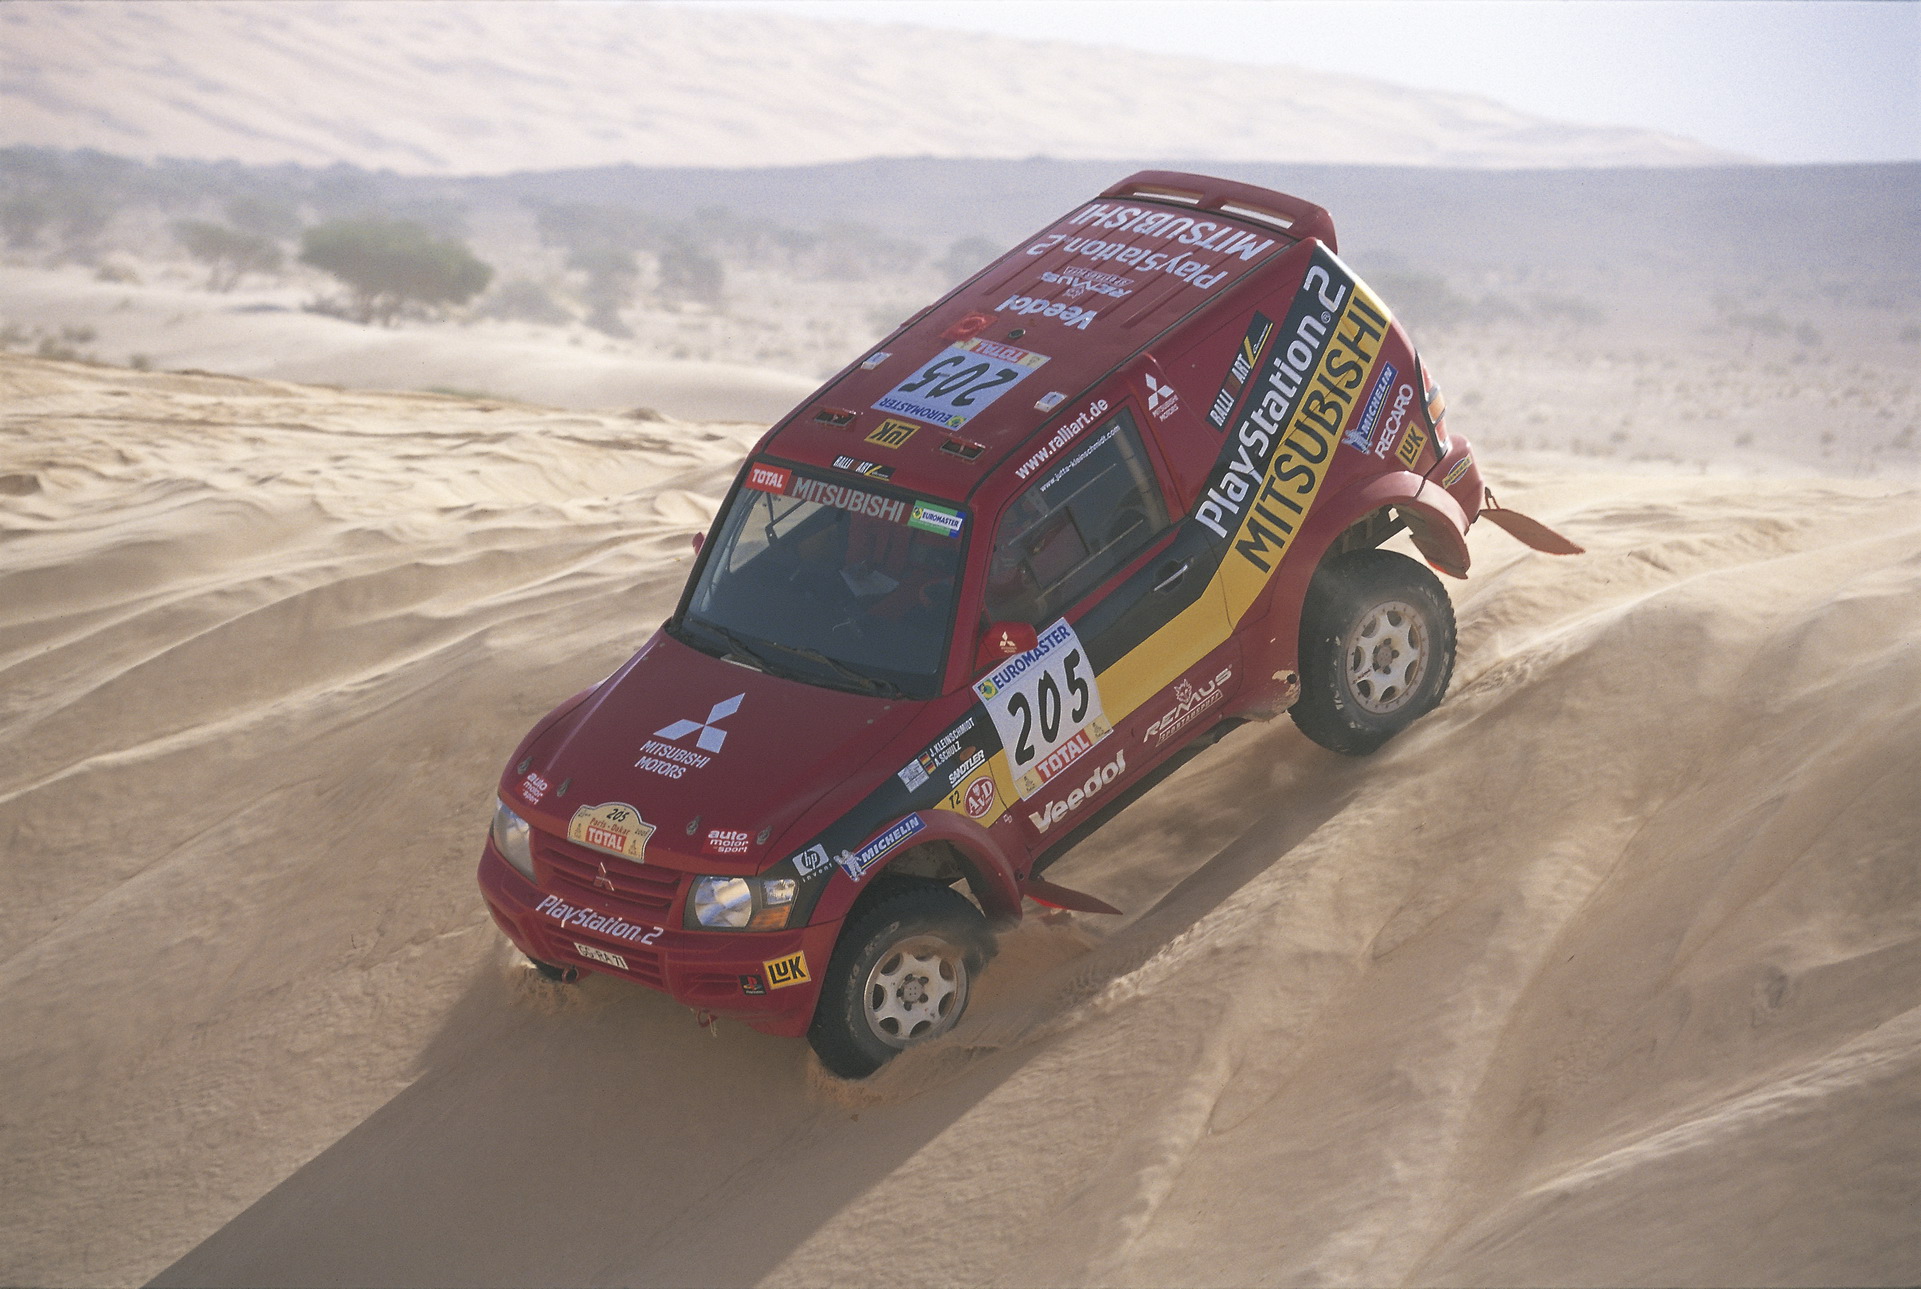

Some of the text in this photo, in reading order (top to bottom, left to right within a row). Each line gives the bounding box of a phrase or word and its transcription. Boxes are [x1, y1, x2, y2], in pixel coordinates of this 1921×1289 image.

[1069, 203, 1275, 261] MITSUBISHI
[994, 294, 1098, 330] Veedol
[975, 340, 1025, 362] TOTAL
[897, 354, 1018, 407] 205
[878, 397, 953, 424] EUROMASTER
[1194, 265, 1346, 538] PlayStation 2
[1361, 366, 1393, 434] MICHELIN
[1015, 399, 1109, 480] www.ralliart.de
[1234, 296, 1388, 573] MITSUBISHI
[1374, 383, 1414, 460] RECARO
[752, 468, 783, 489] TOTAL
[792, 476, 906, 523] MITSUBISHI
[922, 511, 960, 528] EUROMASTER
[992, 625, 1071, 690] EUROMASTER
[1007, 648, 1089, 766] 205
[1143, 668, 1232, 743] REMUS
[634, 756, 687, 779] MOTORS
[639, 740, 711, 769] MITSUBISHI
[948, 749, 985, 785] SANDTLER
[1037, 734, 1090, 778] TOTAL
[523, 781, 543, 797] motor
[527, 772, 548, 791] auto
[949, 790, 961, 809] T2
[966, 780, 994, 815] AvD
[1029, 750, 1126, 834] Veedol
[606, 808, 630, 822] 205
[588, 828, 622, 850] TOTAL
[708, 830, 748, 841] auto
[710, 839, 749, 847] motor
[717, 846, 748, 854] sport
[861, 816, 920, 863] MICHELIN
[804, 851, 819, 870] hp
[535, 894, 664, 946] PlayStation 2
